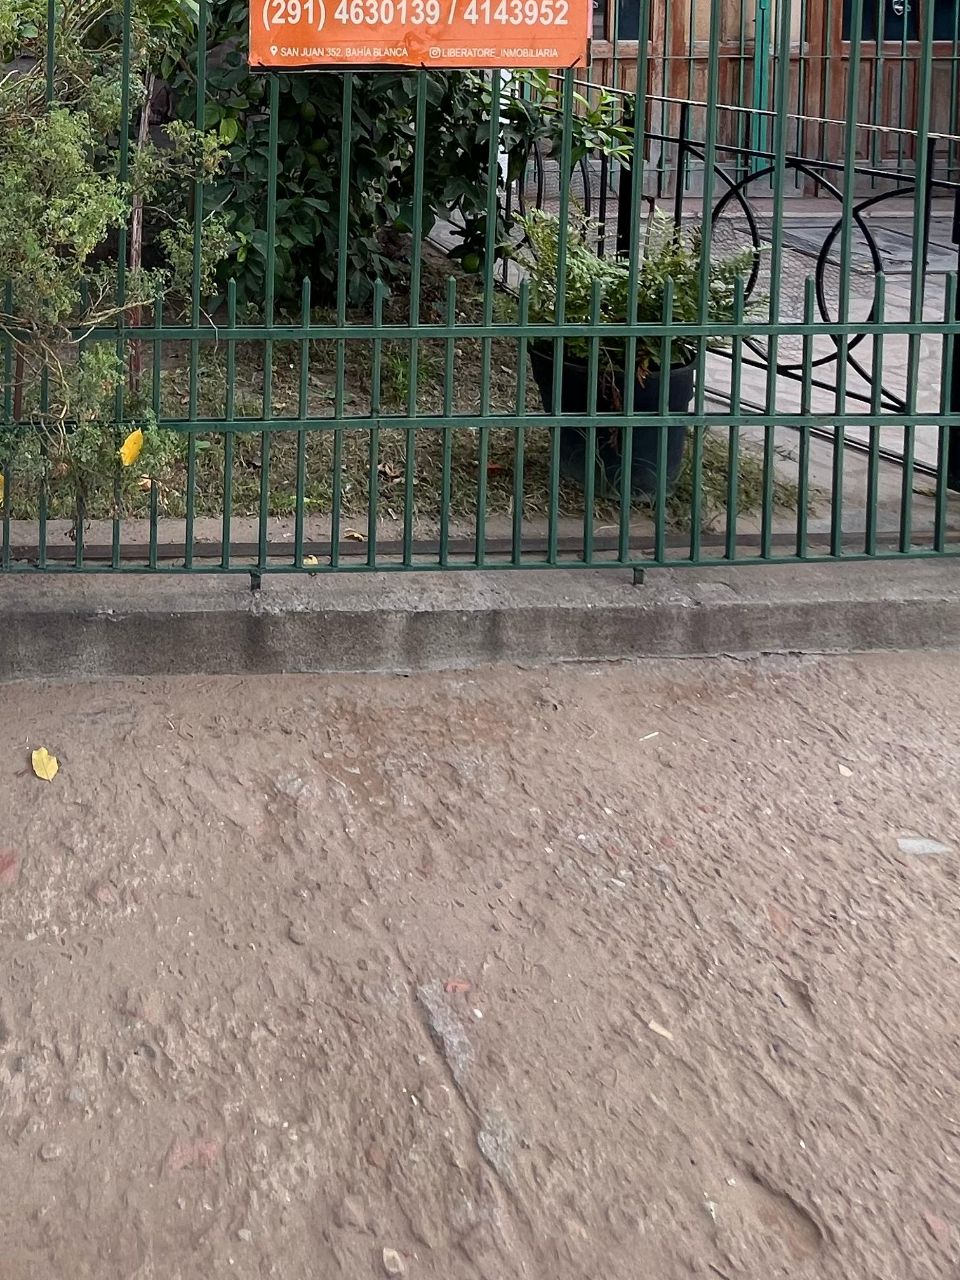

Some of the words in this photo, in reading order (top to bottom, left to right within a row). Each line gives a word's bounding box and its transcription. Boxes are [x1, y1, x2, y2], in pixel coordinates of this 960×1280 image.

[448, 0, 457, 25] /
[463, 0, 569, 25] 4143952
[280, 47, 299, 57] SAN
[300, 47, 325, 57] JUAN
[345, 46, 371, 57] BAHÍA
[372, 47, 409, 57] BLANCA
[441, 47, 559, 59] LIBERATORE_INMOBILIARIA
